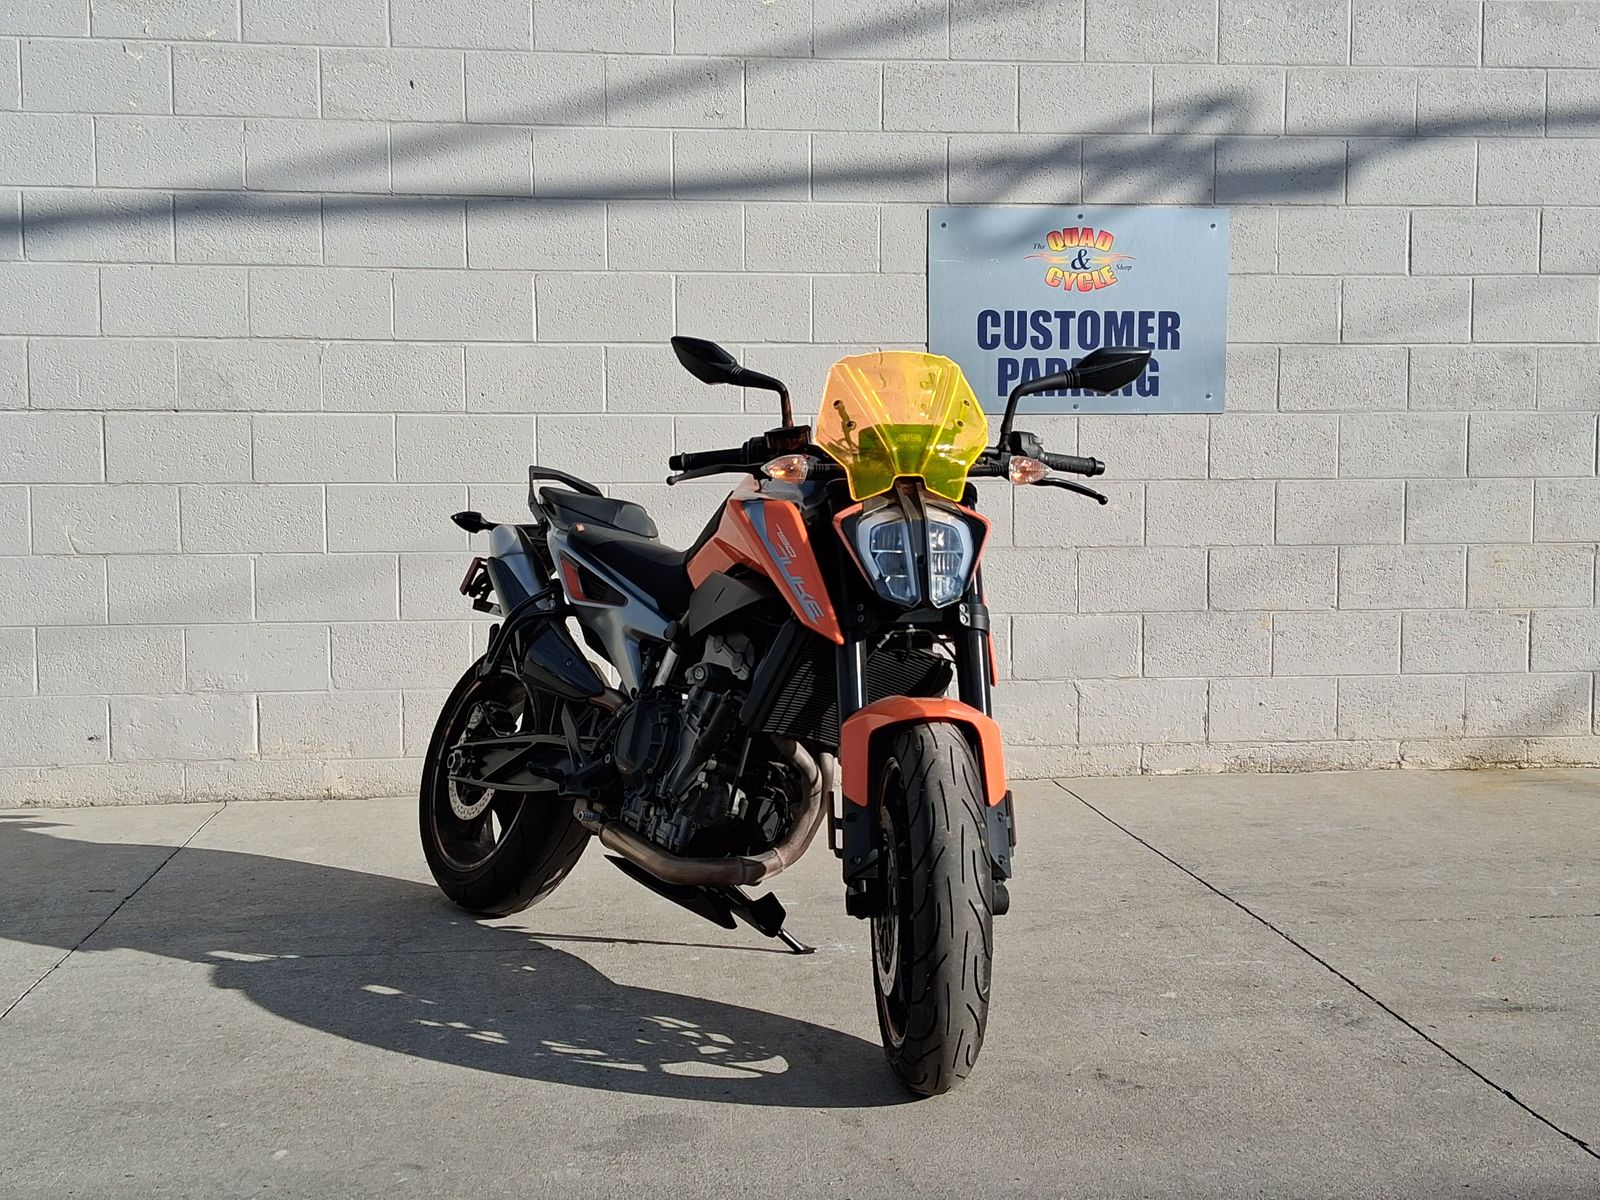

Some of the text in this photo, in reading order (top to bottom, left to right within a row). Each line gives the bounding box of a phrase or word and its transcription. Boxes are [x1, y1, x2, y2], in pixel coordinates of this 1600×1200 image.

[1046, 227, 1114, 252] QUAD
[1071, 248, 1091, 270] &
[1045, 263, 1132, 292] CYCLE Shop
[977, 309, 1181, 350] CUSTOMER
[998, 357, 1160, 397] PARG
